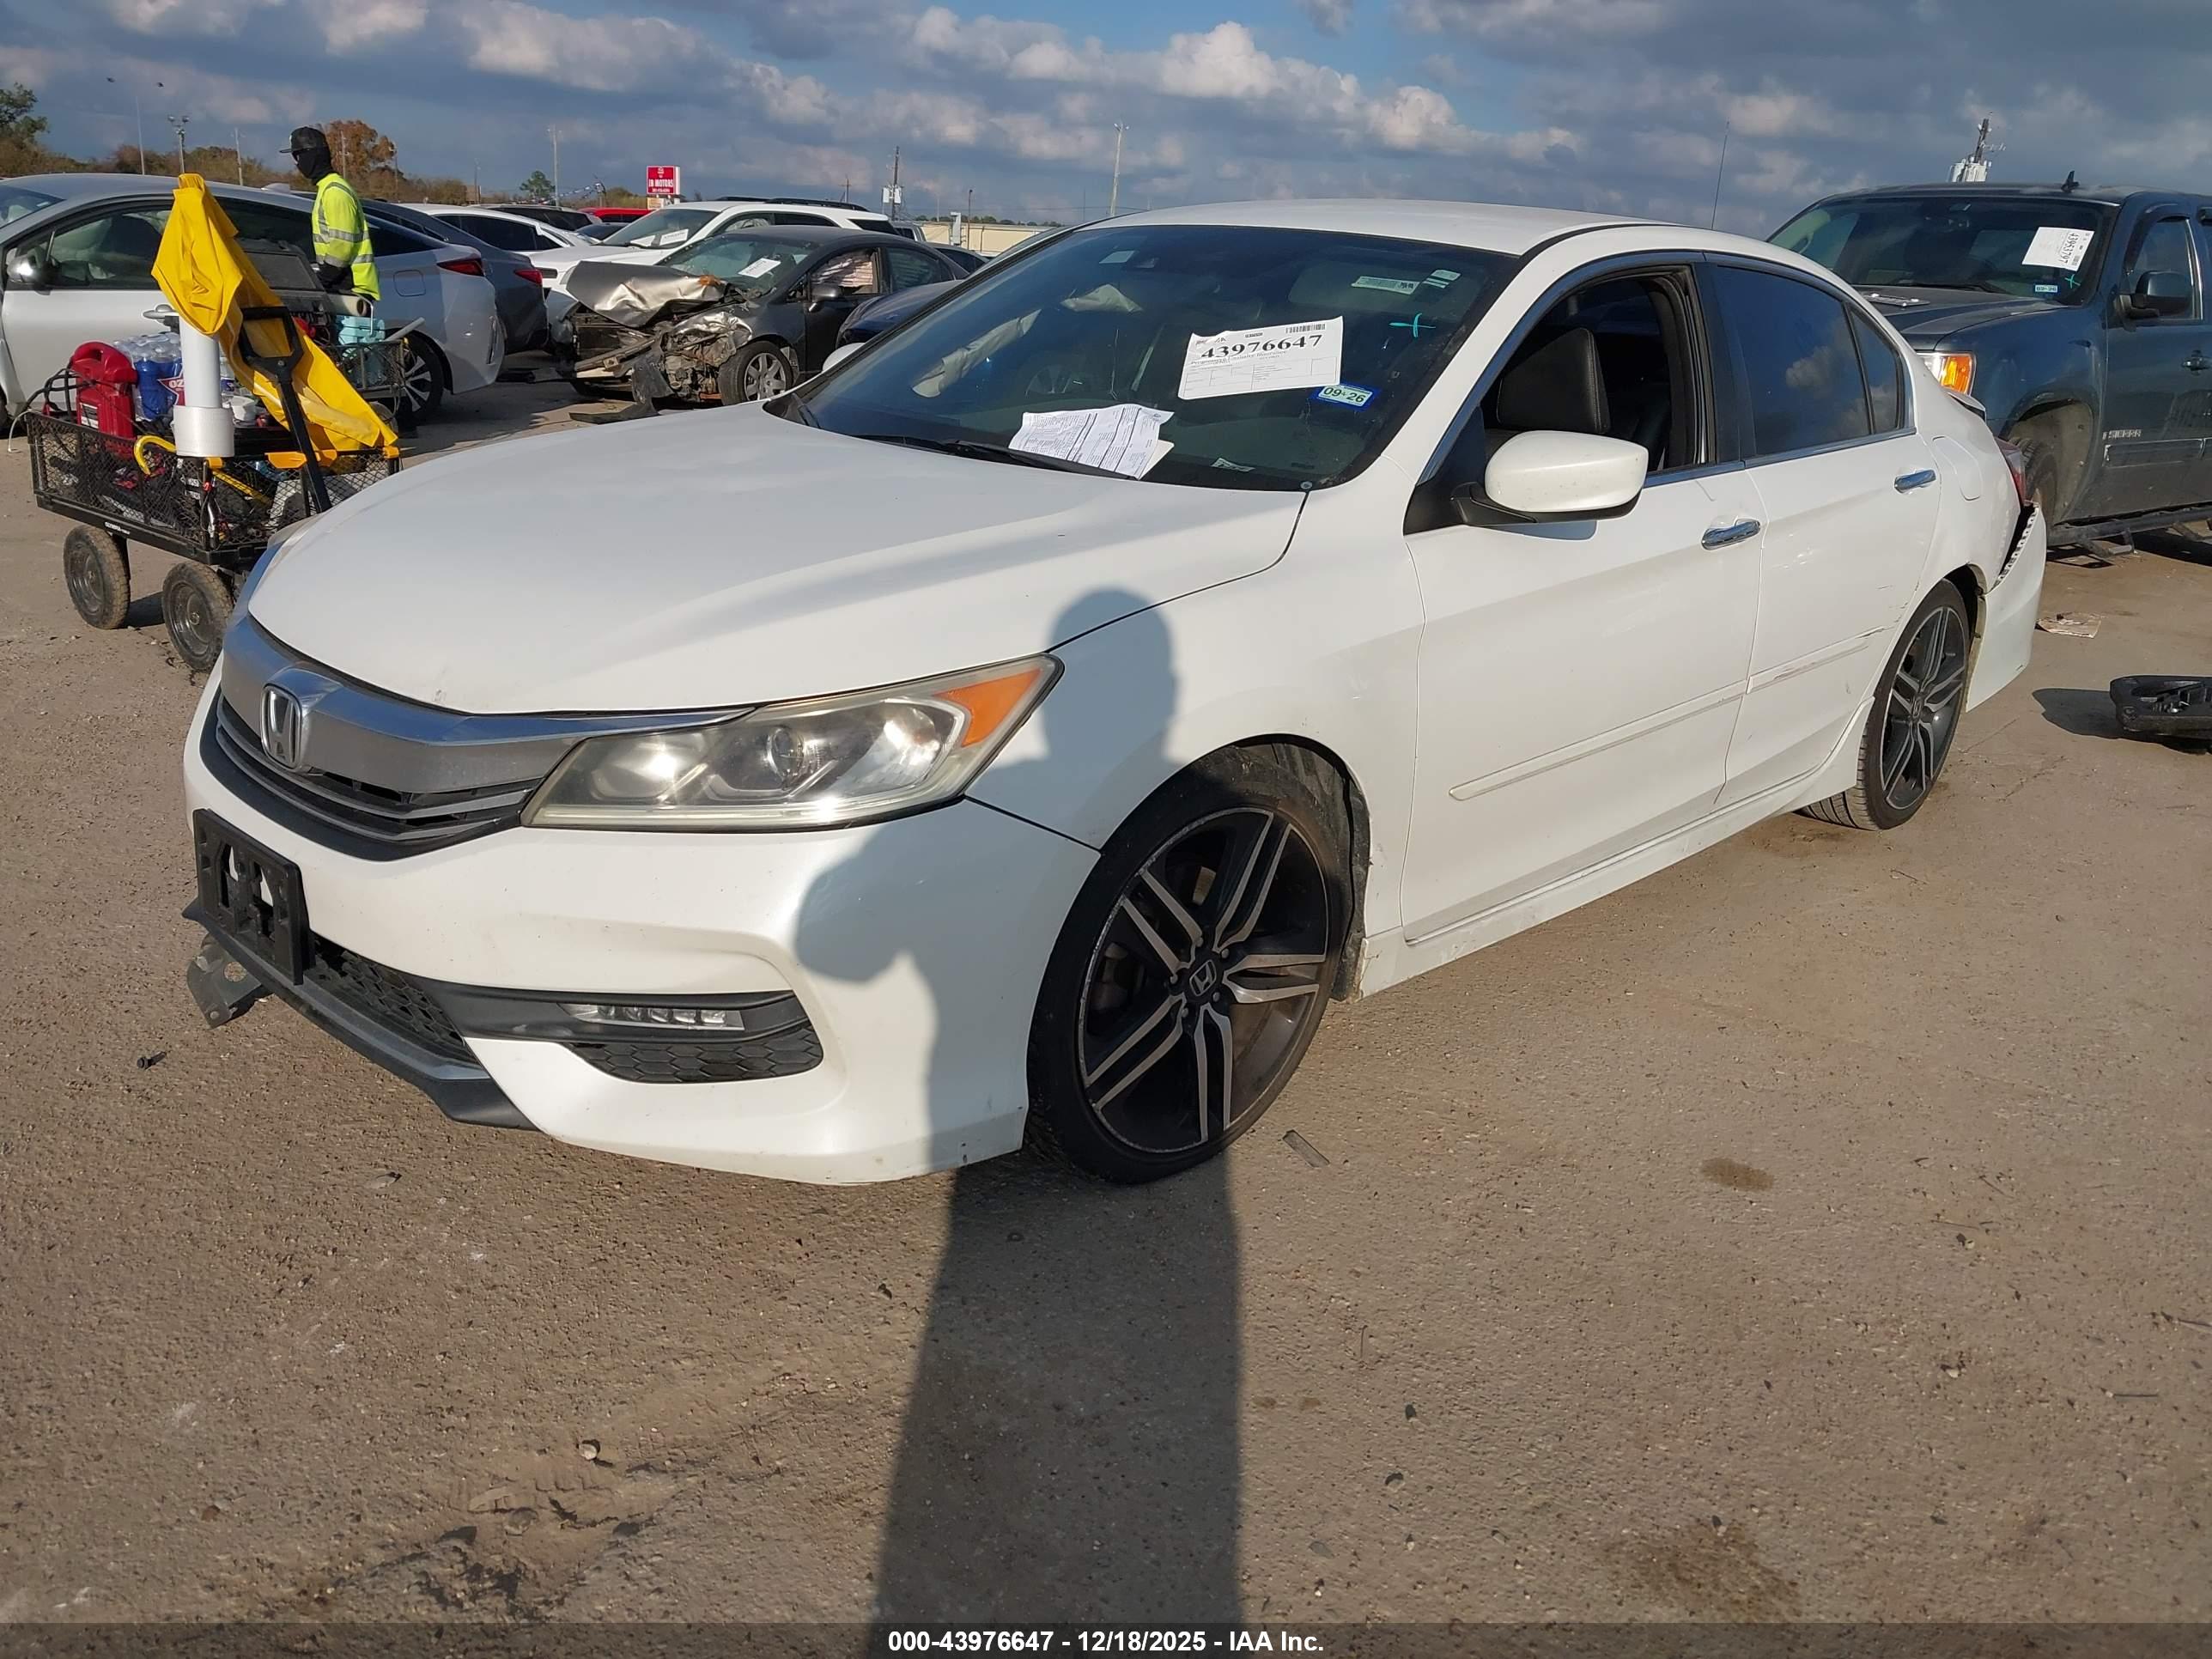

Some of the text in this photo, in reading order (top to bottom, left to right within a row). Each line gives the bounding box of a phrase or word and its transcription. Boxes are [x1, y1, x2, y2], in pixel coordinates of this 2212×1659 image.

[654, 179, 673, 187] MOTORS
[1201, 334, 1322, 358] 43976647
[1323, 387, 1342, 397] 09
[1346, 392, 1365, 403] 26
